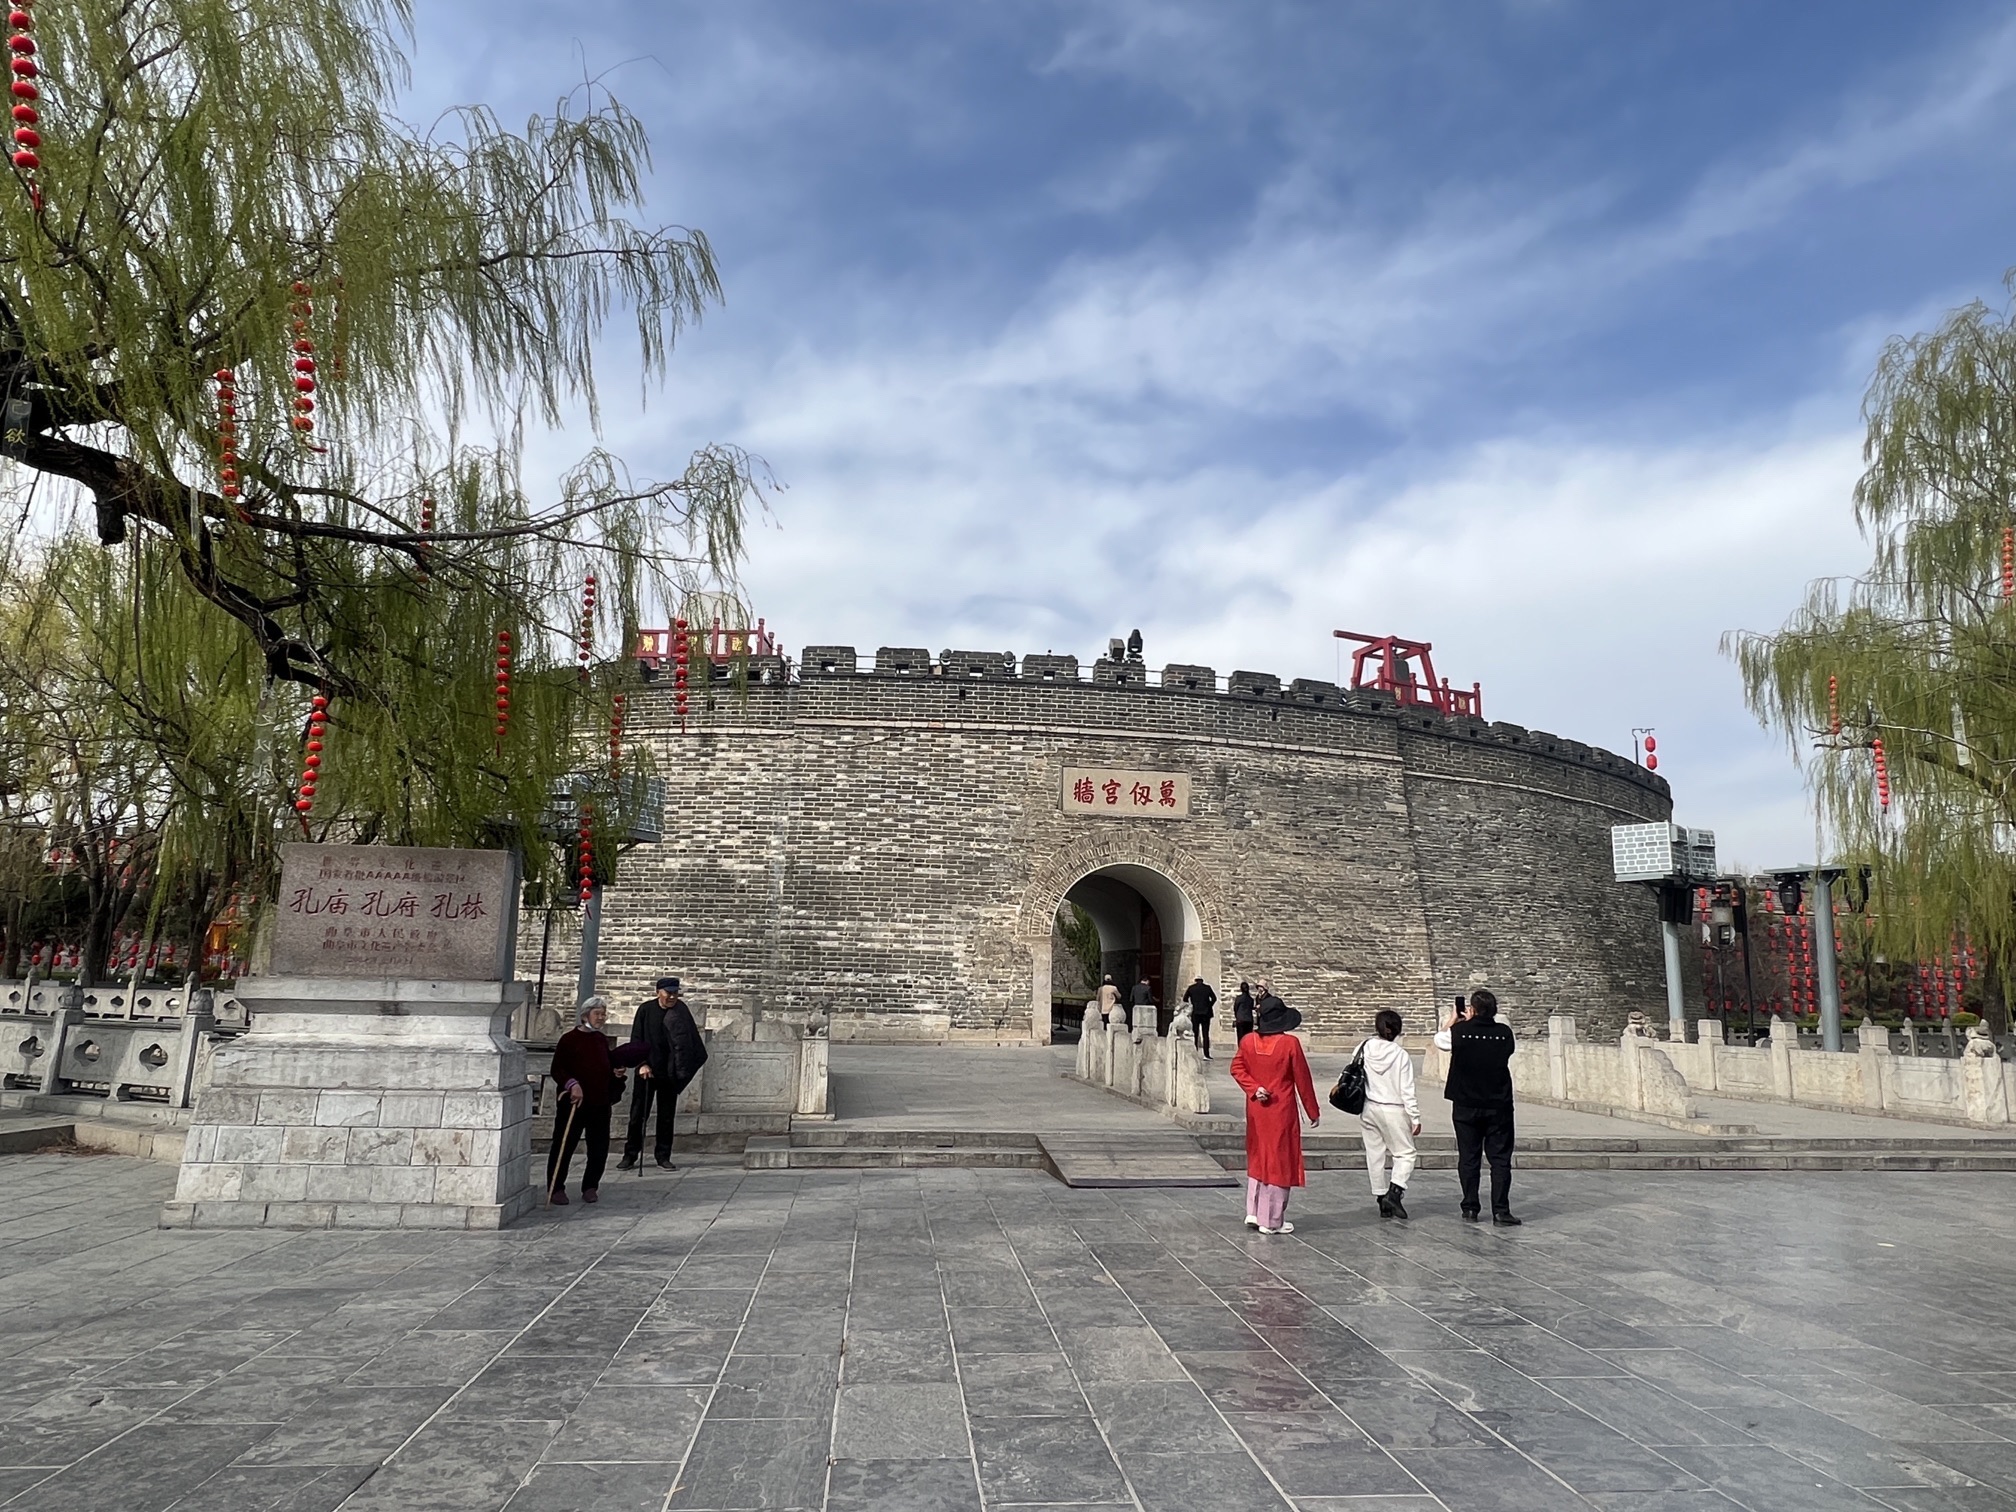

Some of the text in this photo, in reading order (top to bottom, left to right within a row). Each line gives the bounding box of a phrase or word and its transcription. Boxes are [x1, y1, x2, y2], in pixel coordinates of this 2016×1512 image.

[290, 887, 487, 920] 孔庙 孔府 孔林
